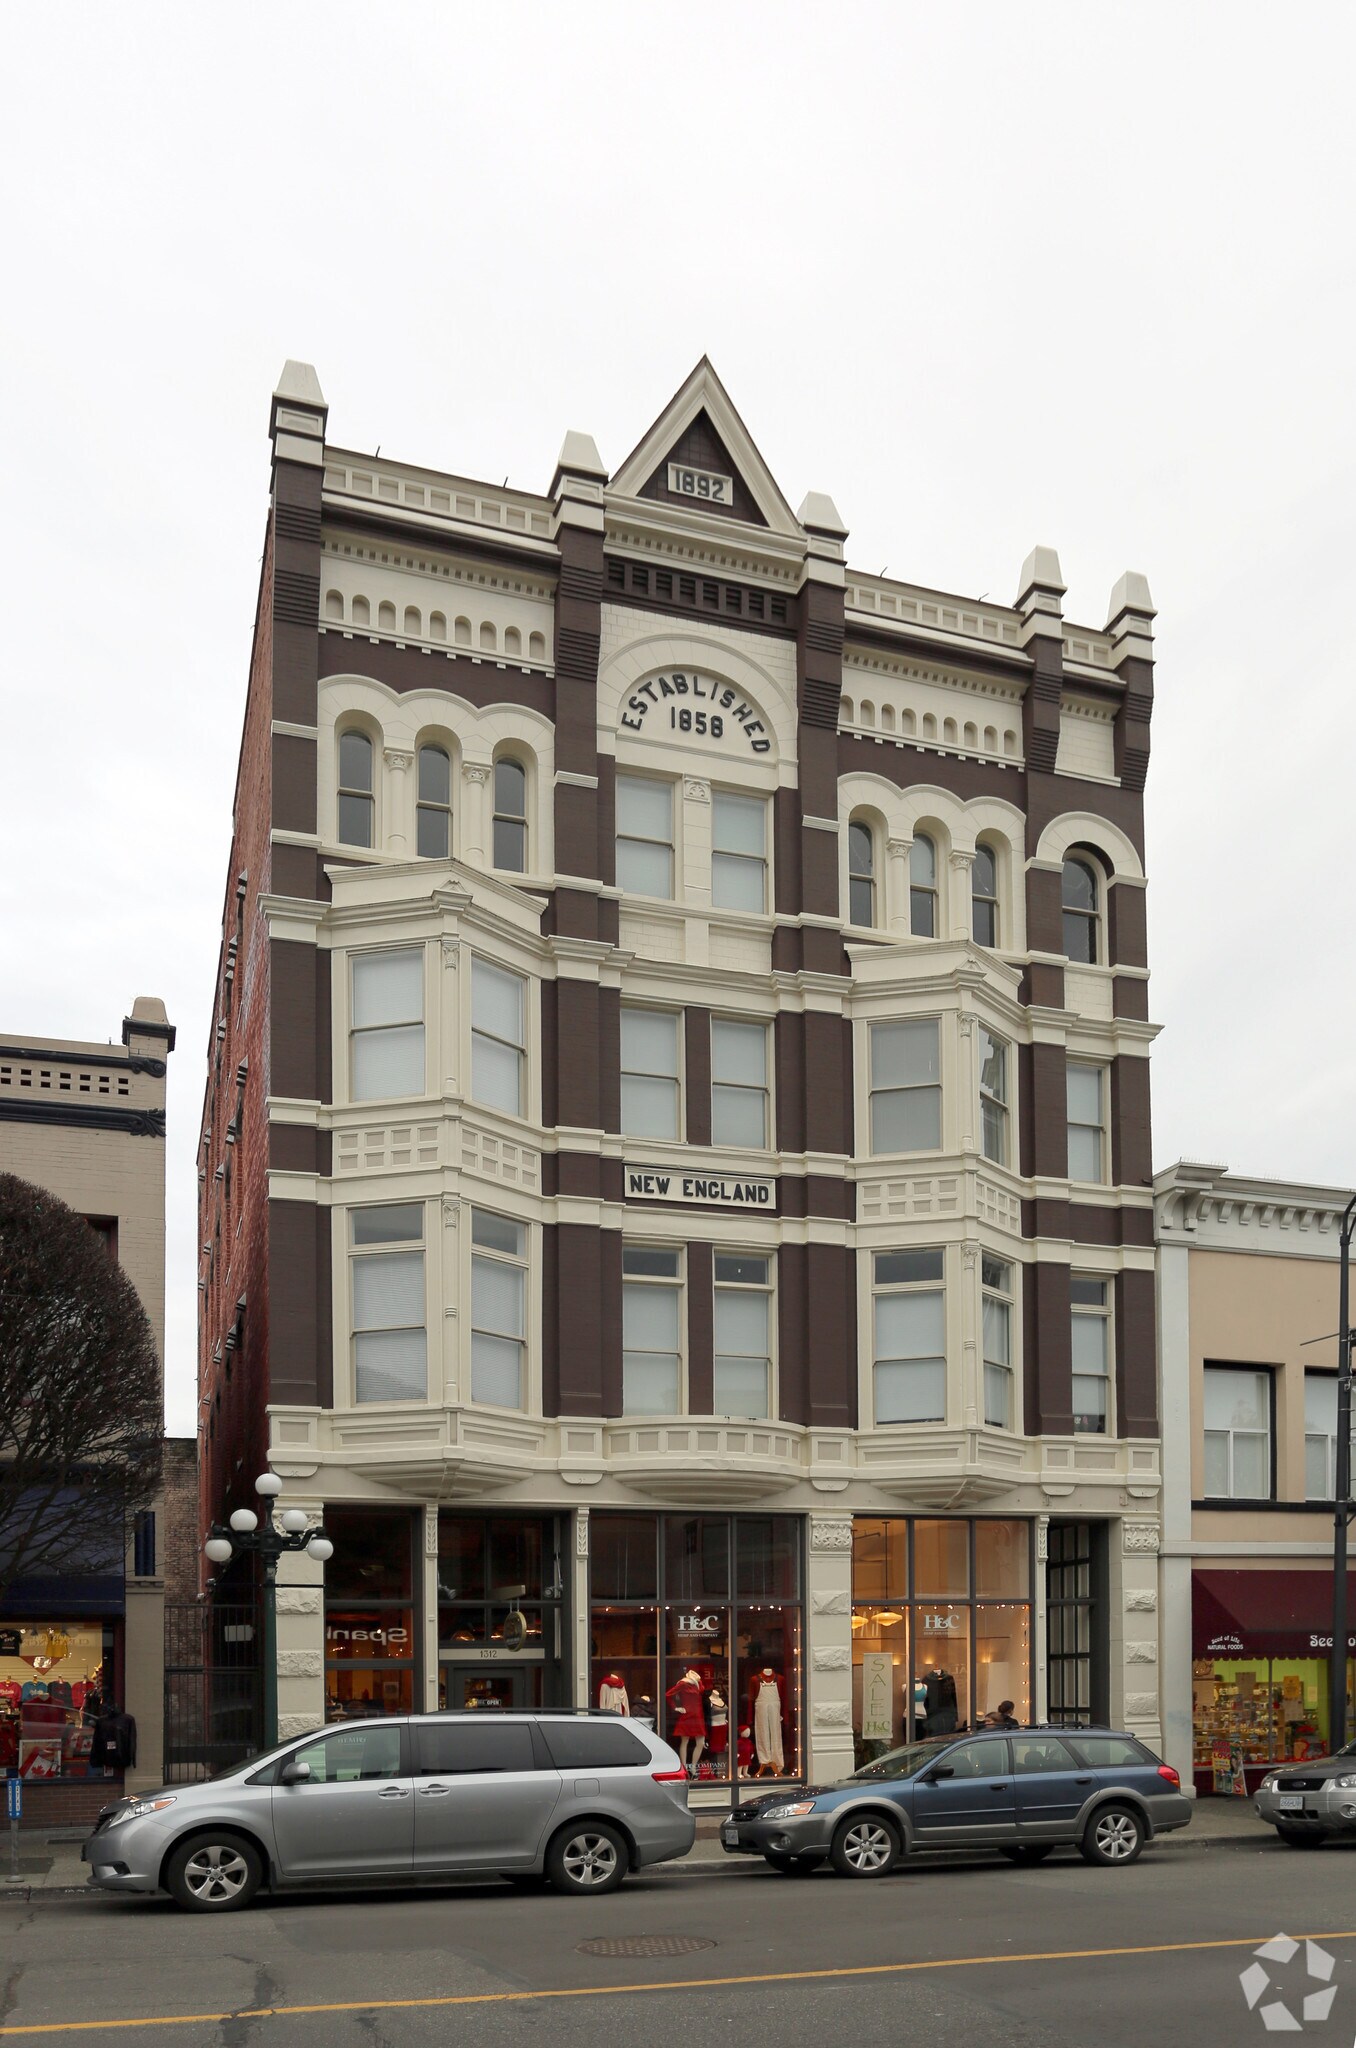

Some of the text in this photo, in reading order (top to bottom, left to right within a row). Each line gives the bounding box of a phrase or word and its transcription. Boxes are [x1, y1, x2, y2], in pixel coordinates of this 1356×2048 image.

[676, 469, 725, 501] 1892
[621, 673, 771, 752] ESTABLISHED
[671, 706, 723, 738] 1858
[630, 1174, 769, 1203] NEW ENGLAND
[677, 1615, 719, 1631] H&C
[924, 1614, 960, 1629] H&C
[480, 1650, 498, 1659] 1312
[869, 1657, 887, 1717] SALE
